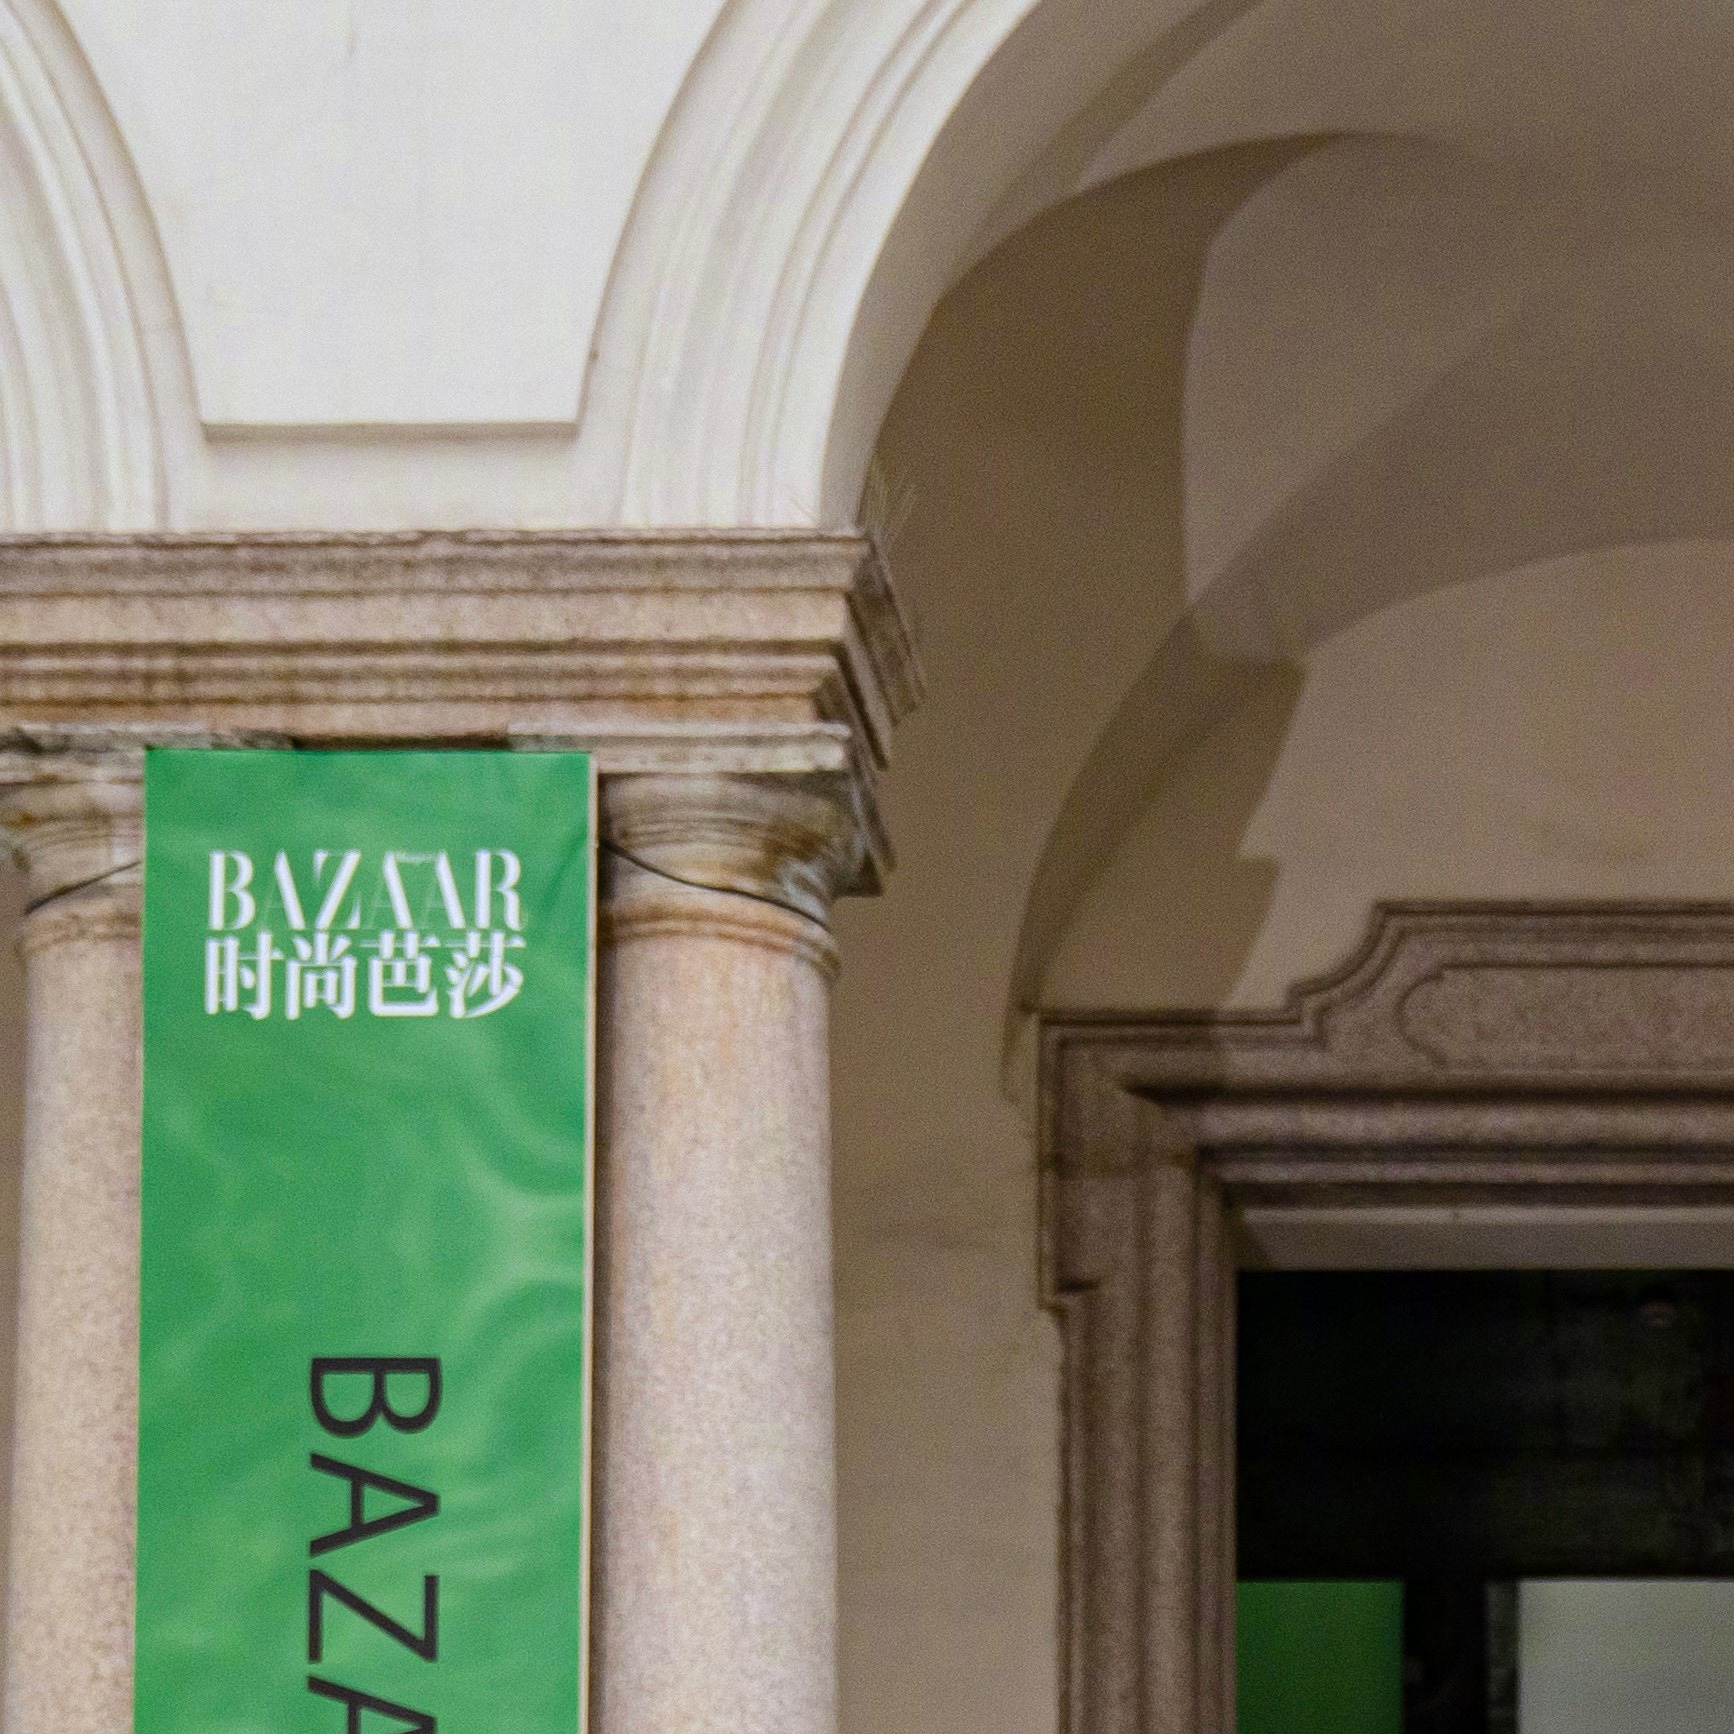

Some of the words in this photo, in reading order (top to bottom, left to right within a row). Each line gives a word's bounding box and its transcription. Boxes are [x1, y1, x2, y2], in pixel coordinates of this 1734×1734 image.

[207, 850, 524, 930] BAZAAR
[205, 930, 526, 1020] 时尚芭莎
